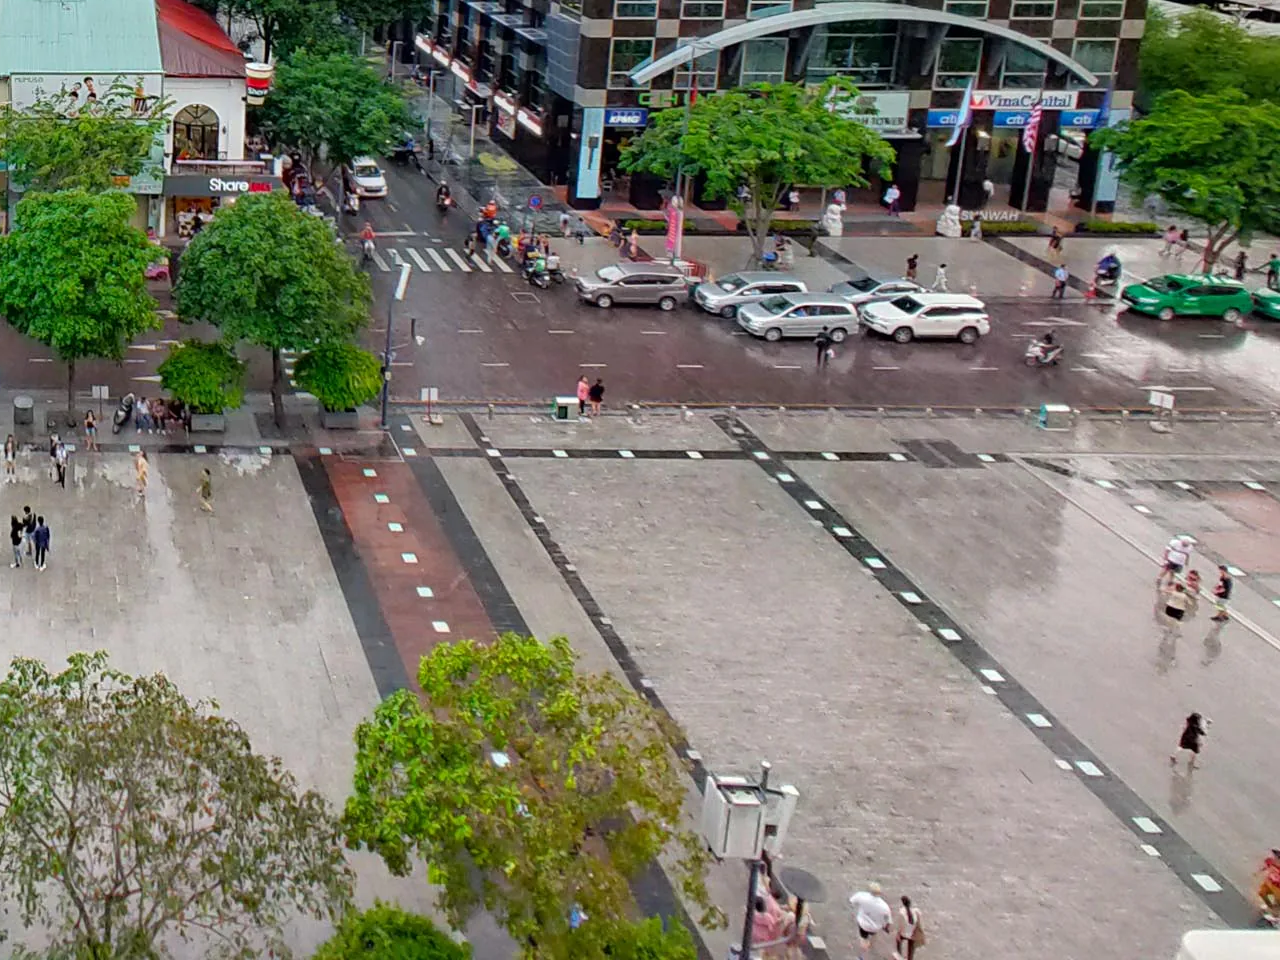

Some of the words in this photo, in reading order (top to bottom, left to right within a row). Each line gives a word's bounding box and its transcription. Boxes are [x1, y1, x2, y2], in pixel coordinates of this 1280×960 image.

[609, 115, 641, 124] KPMG
[872, 117, 905, 125] TOWER
[1006, 113, 1025, 124] citi
[1073, 113, 1092, 124] citi
